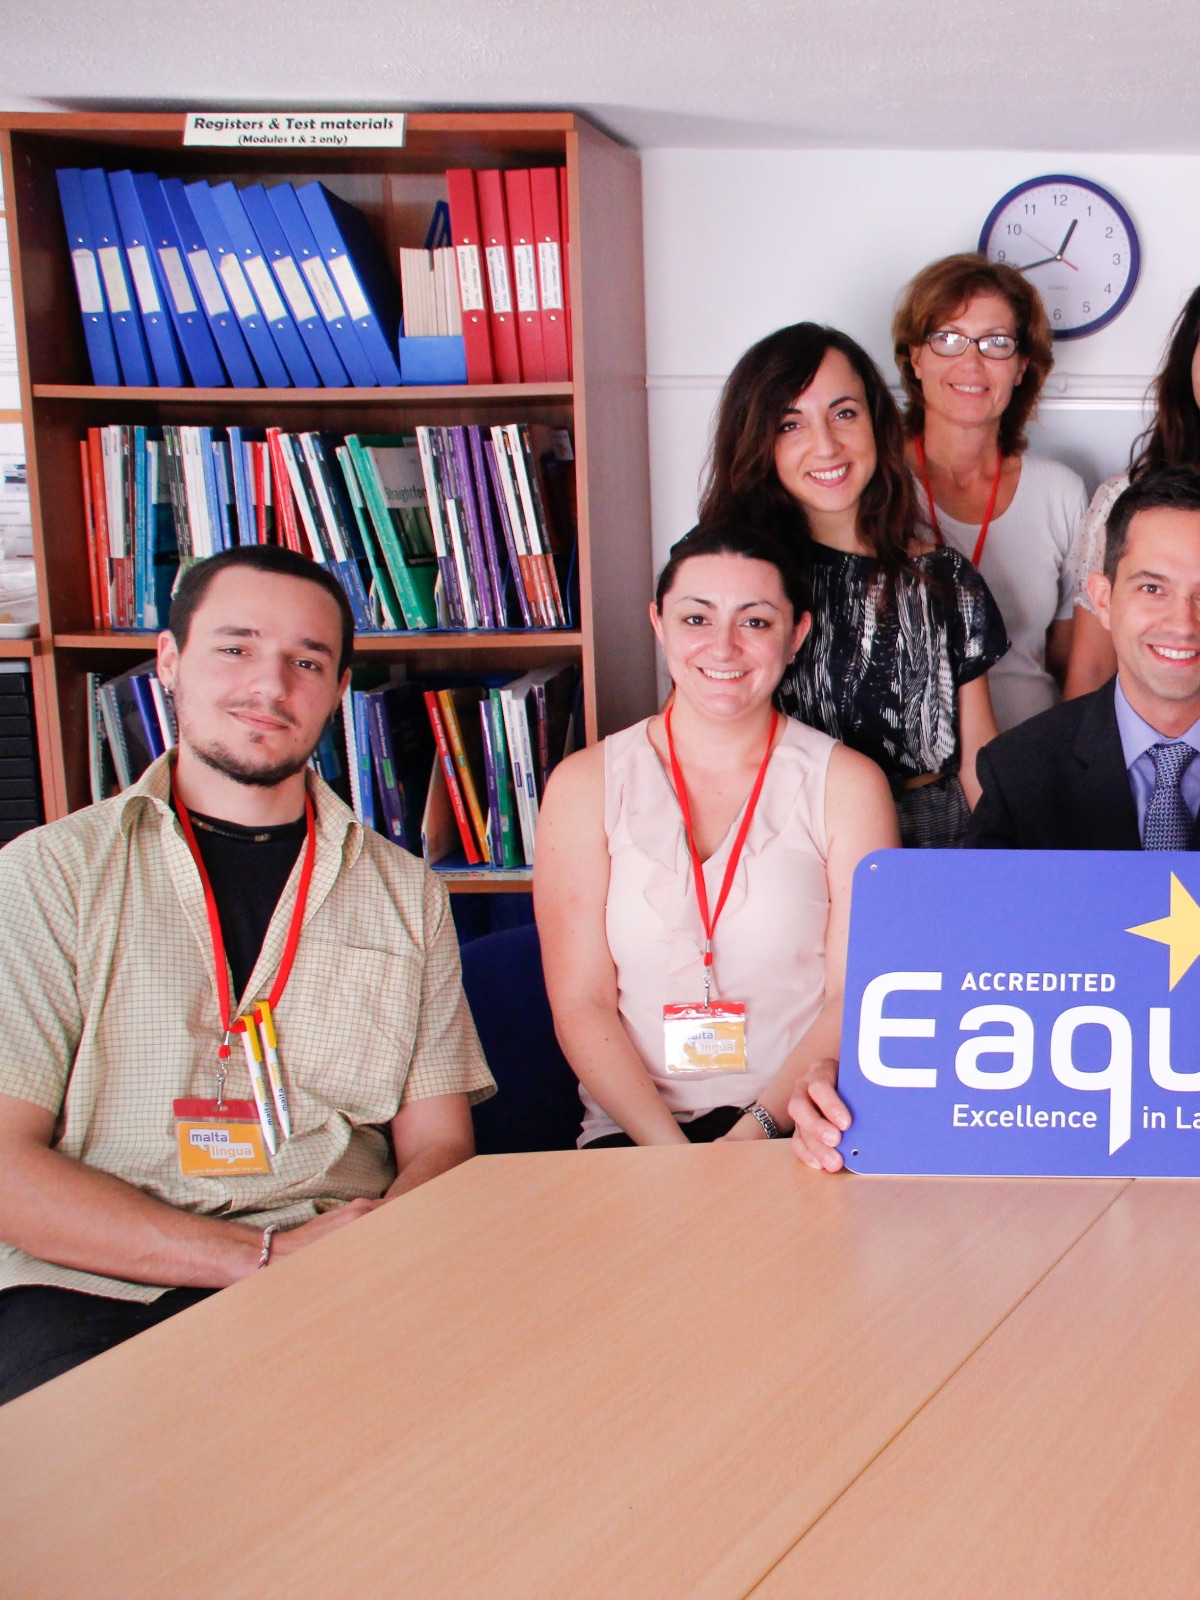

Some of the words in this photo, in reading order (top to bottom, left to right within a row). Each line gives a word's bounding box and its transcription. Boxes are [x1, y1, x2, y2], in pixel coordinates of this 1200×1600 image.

[194, 117, 263, 130] Registers
[268, 117, 280, 130] &
[286, 117, 316, 130] Test
[321, 117, 394, 130] materials
[238, 135, 288, 146] (Modules
[298, 136, 307, 144] &
[310, 136, 316, 144] 2
[319, 135, 348, 146] only)
[1052, 194, 1068, 207] 12
[1023, 203, 1037, 215] 11
[1086, 205, 1092, 217] 1
[1006, 223, 1022, 236] 10
[1105, 227, 1113, 239] 2
[997, 250, 1006, 262] 9
[1112, 253, 1121, 266] 3
[1103, 283, 1112, 294] 4
[1082, 301, 1091, 313] 5
[1053, 308, 1062, 320] 6
[961, 972, 1116, 992] ACCREDITED
[278, 1088, 288, 1111] malta
[953, 1104, 1098, 1129] Excellence
[1143, 1106, 1166, 1129] in
[191, 1132, 228, 1142] malta
[212, 1145, 252, 1157] lingua
